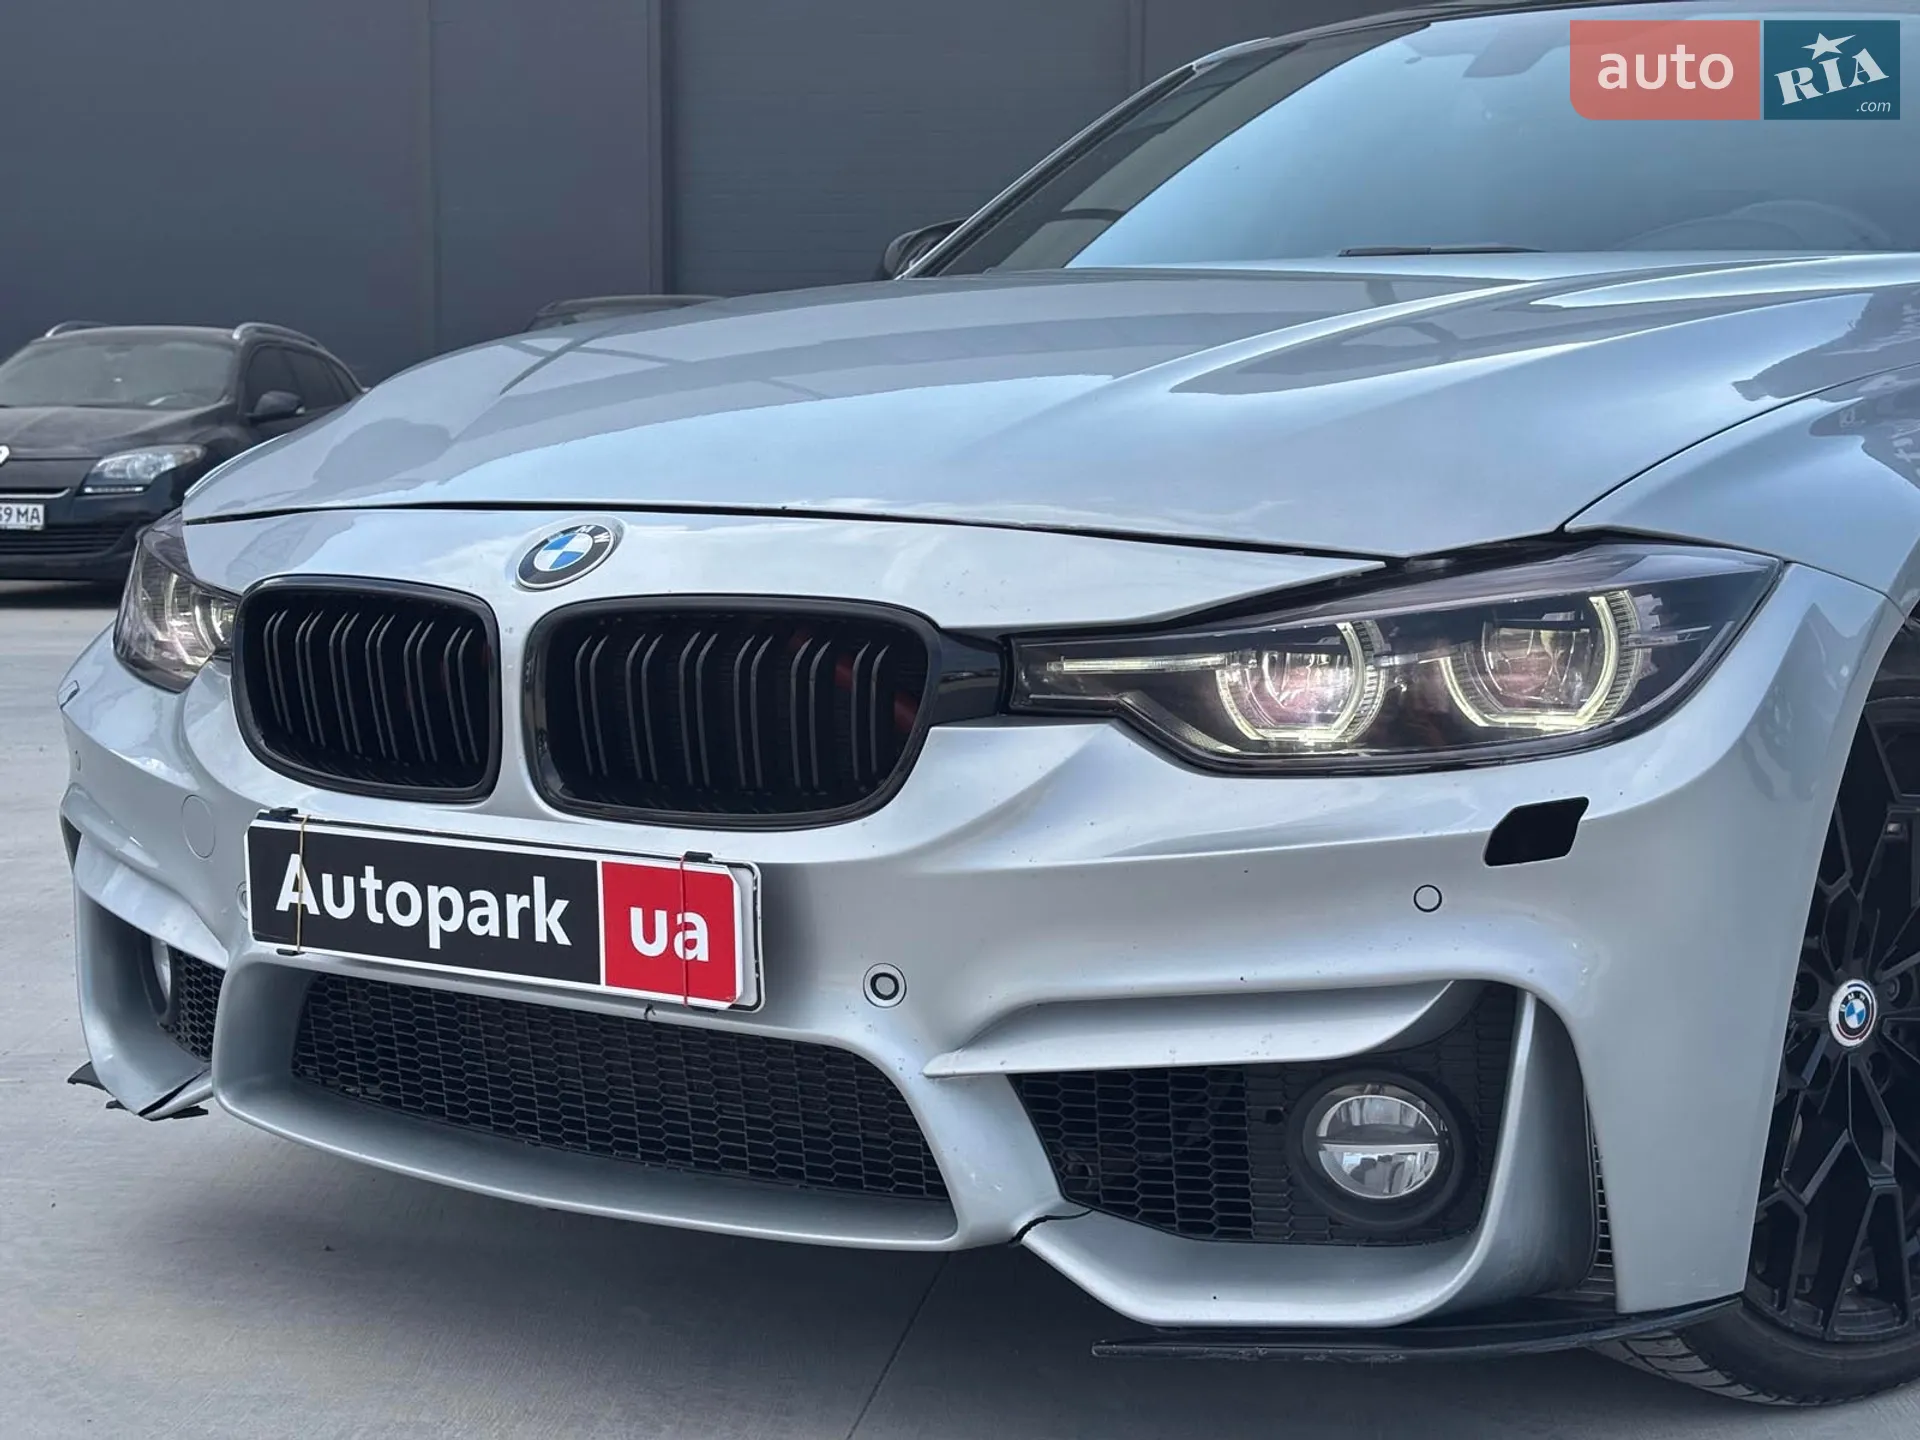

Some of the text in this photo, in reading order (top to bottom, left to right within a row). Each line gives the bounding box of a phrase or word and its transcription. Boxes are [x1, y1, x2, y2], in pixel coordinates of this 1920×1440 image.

[0, 506, 41, 523] 9 MA
[276, 853, 709, 962] Autopark ua
